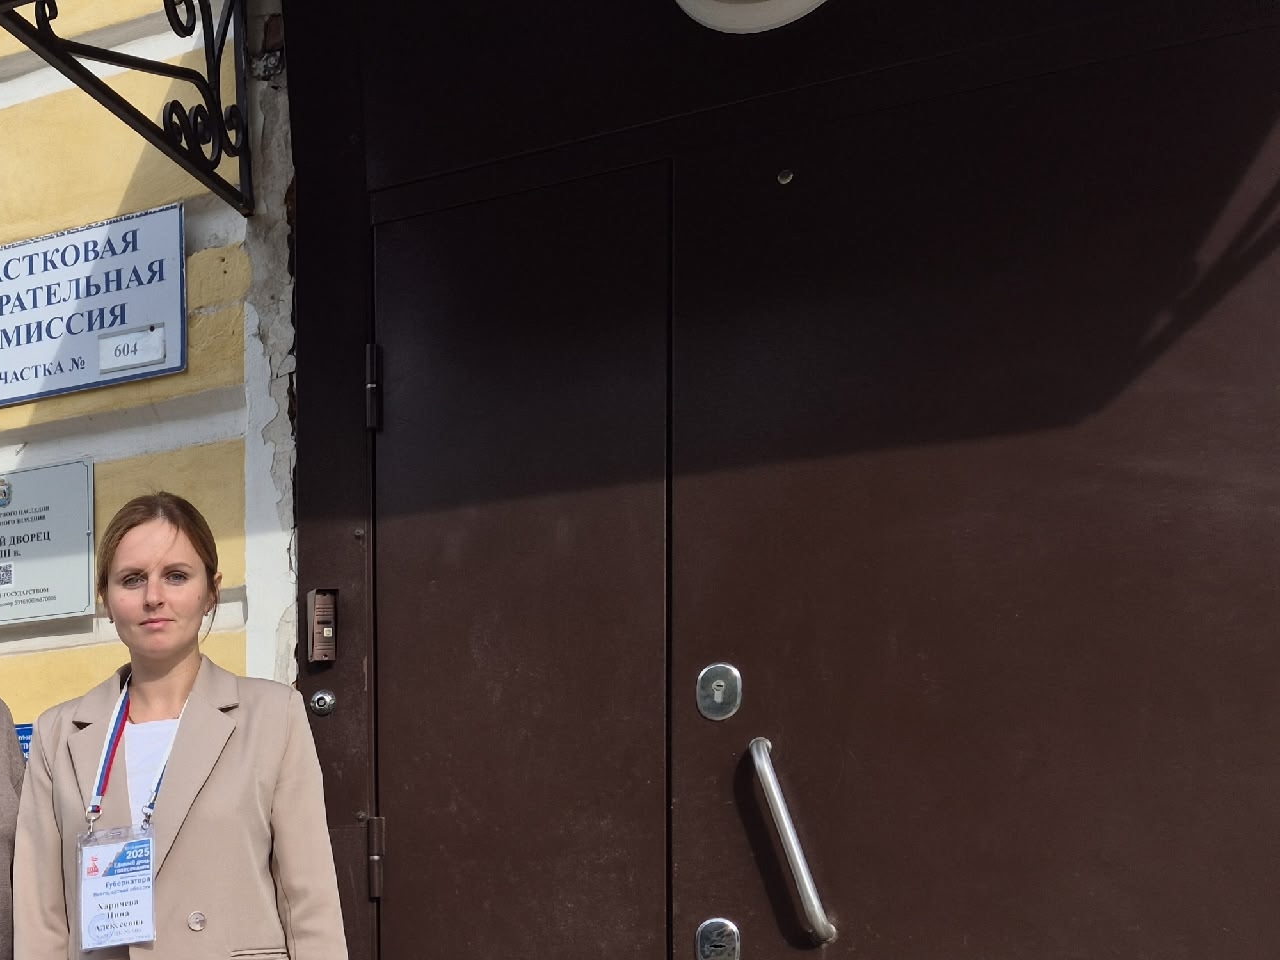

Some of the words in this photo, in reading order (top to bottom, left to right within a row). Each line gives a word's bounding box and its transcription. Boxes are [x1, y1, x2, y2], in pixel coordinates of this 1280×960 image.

[68, 356, 86, 372] №
[114, 343, 139, 358] 604
[9, 531, 51, 547] ДВОРЕЦ
[126, 848, 150, 860] 2025
